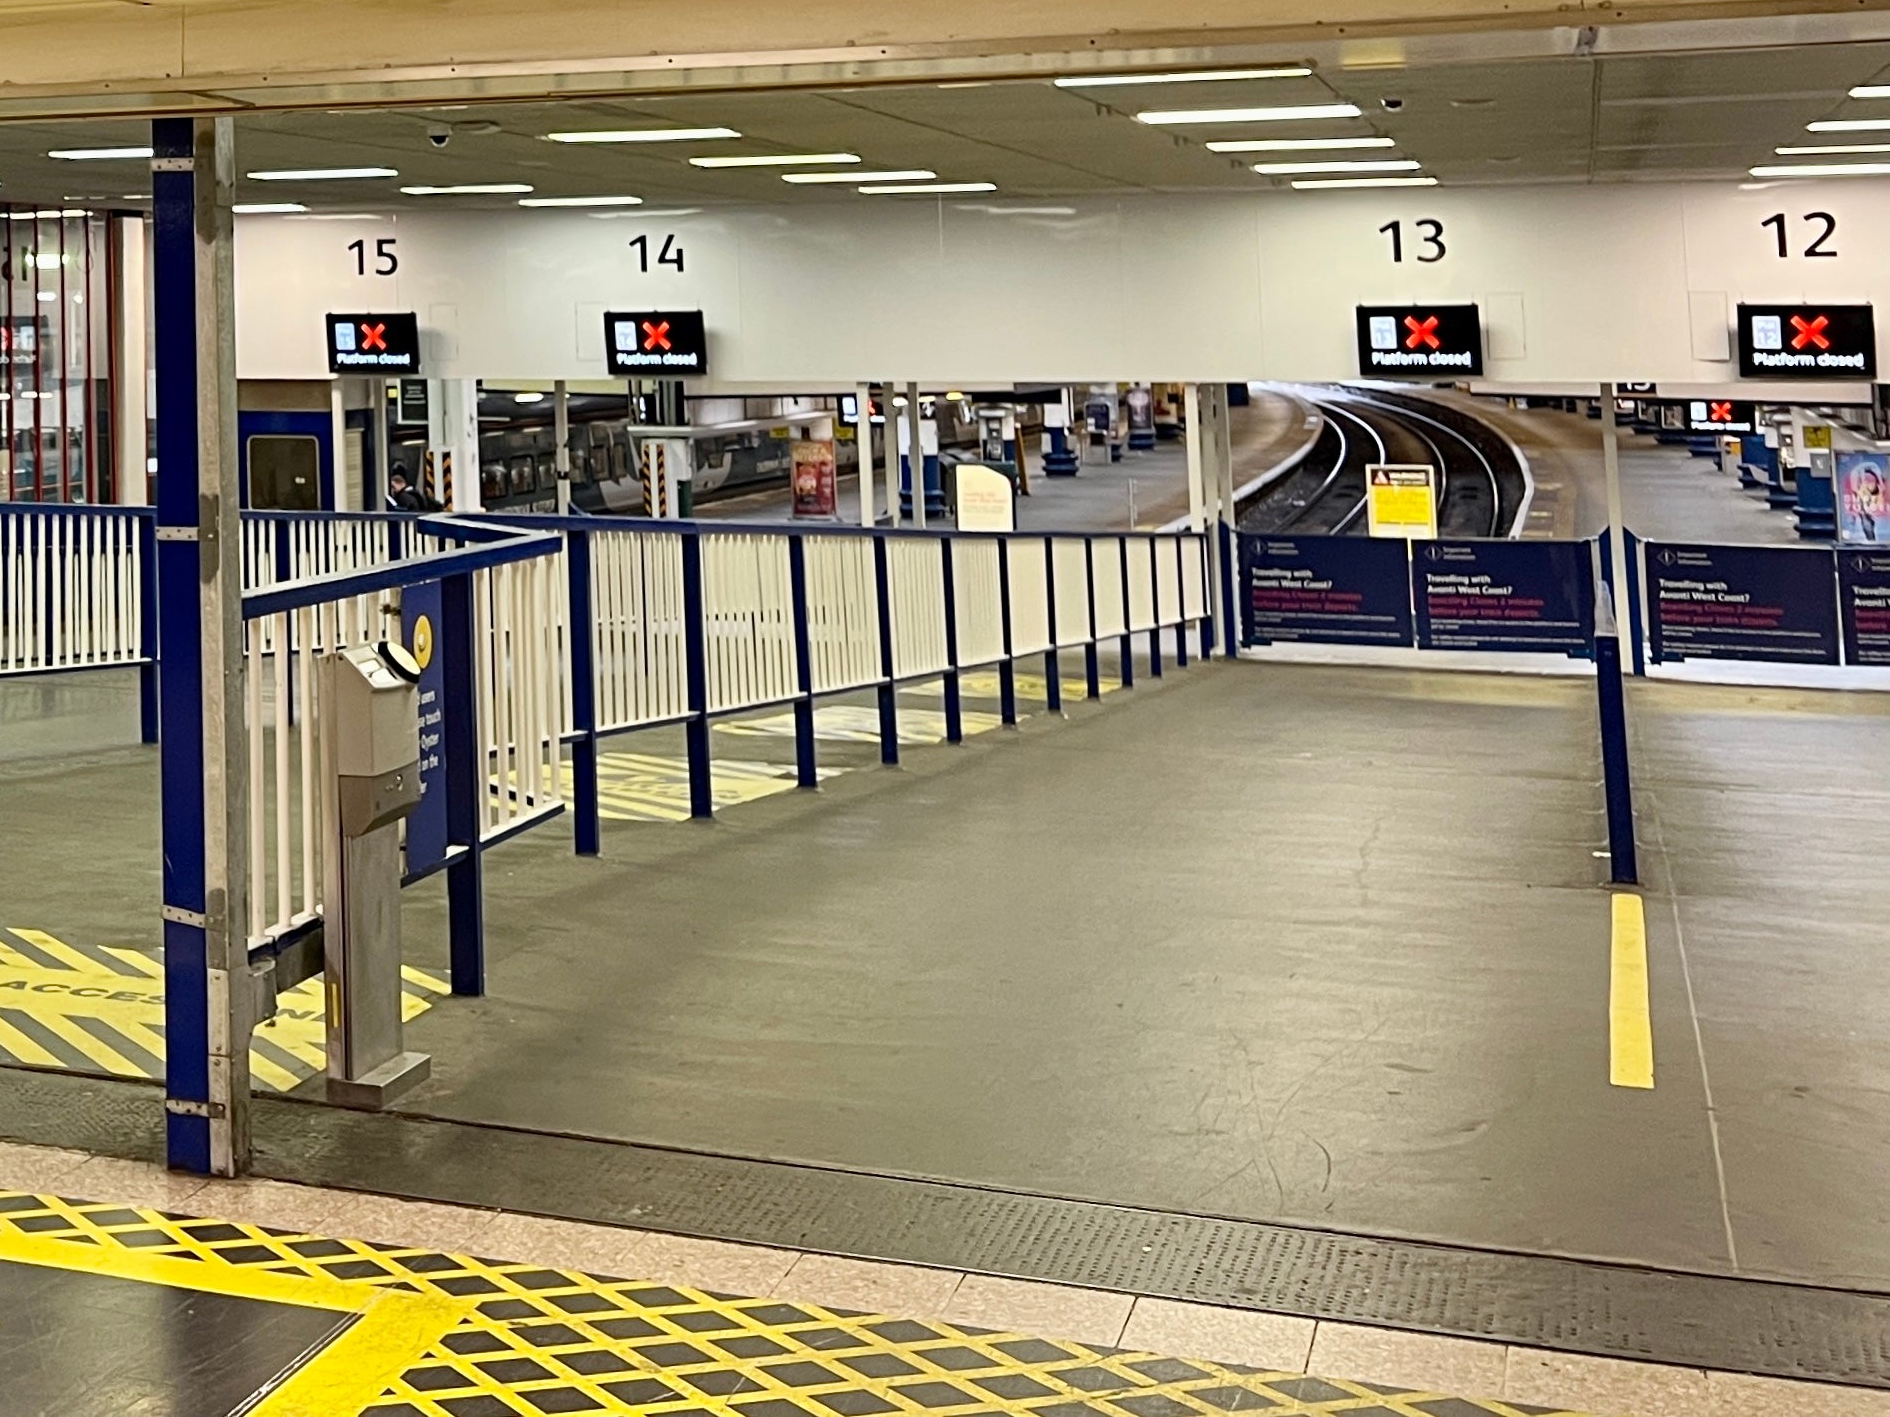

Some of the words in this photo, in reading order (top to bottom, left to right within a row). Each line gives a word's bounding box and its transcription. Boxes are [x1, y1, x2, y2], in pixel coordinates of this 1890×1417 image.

[628, 234, 685, 273] 14
[1378, 218, 1447, 263] 13
[1761, 211, 1838, 258] 12
[347, 238, 399, 276] 15
[1371, 351, 1427, 365] Platform
[1428, 351, 1471, 365] closed
[1752, 351, 1815, 367] Platform
[1816, 352, 1865, 367] closed
[1659, 578, 1704, 591] Travelling
[1706, 581, 1728, 591] with
